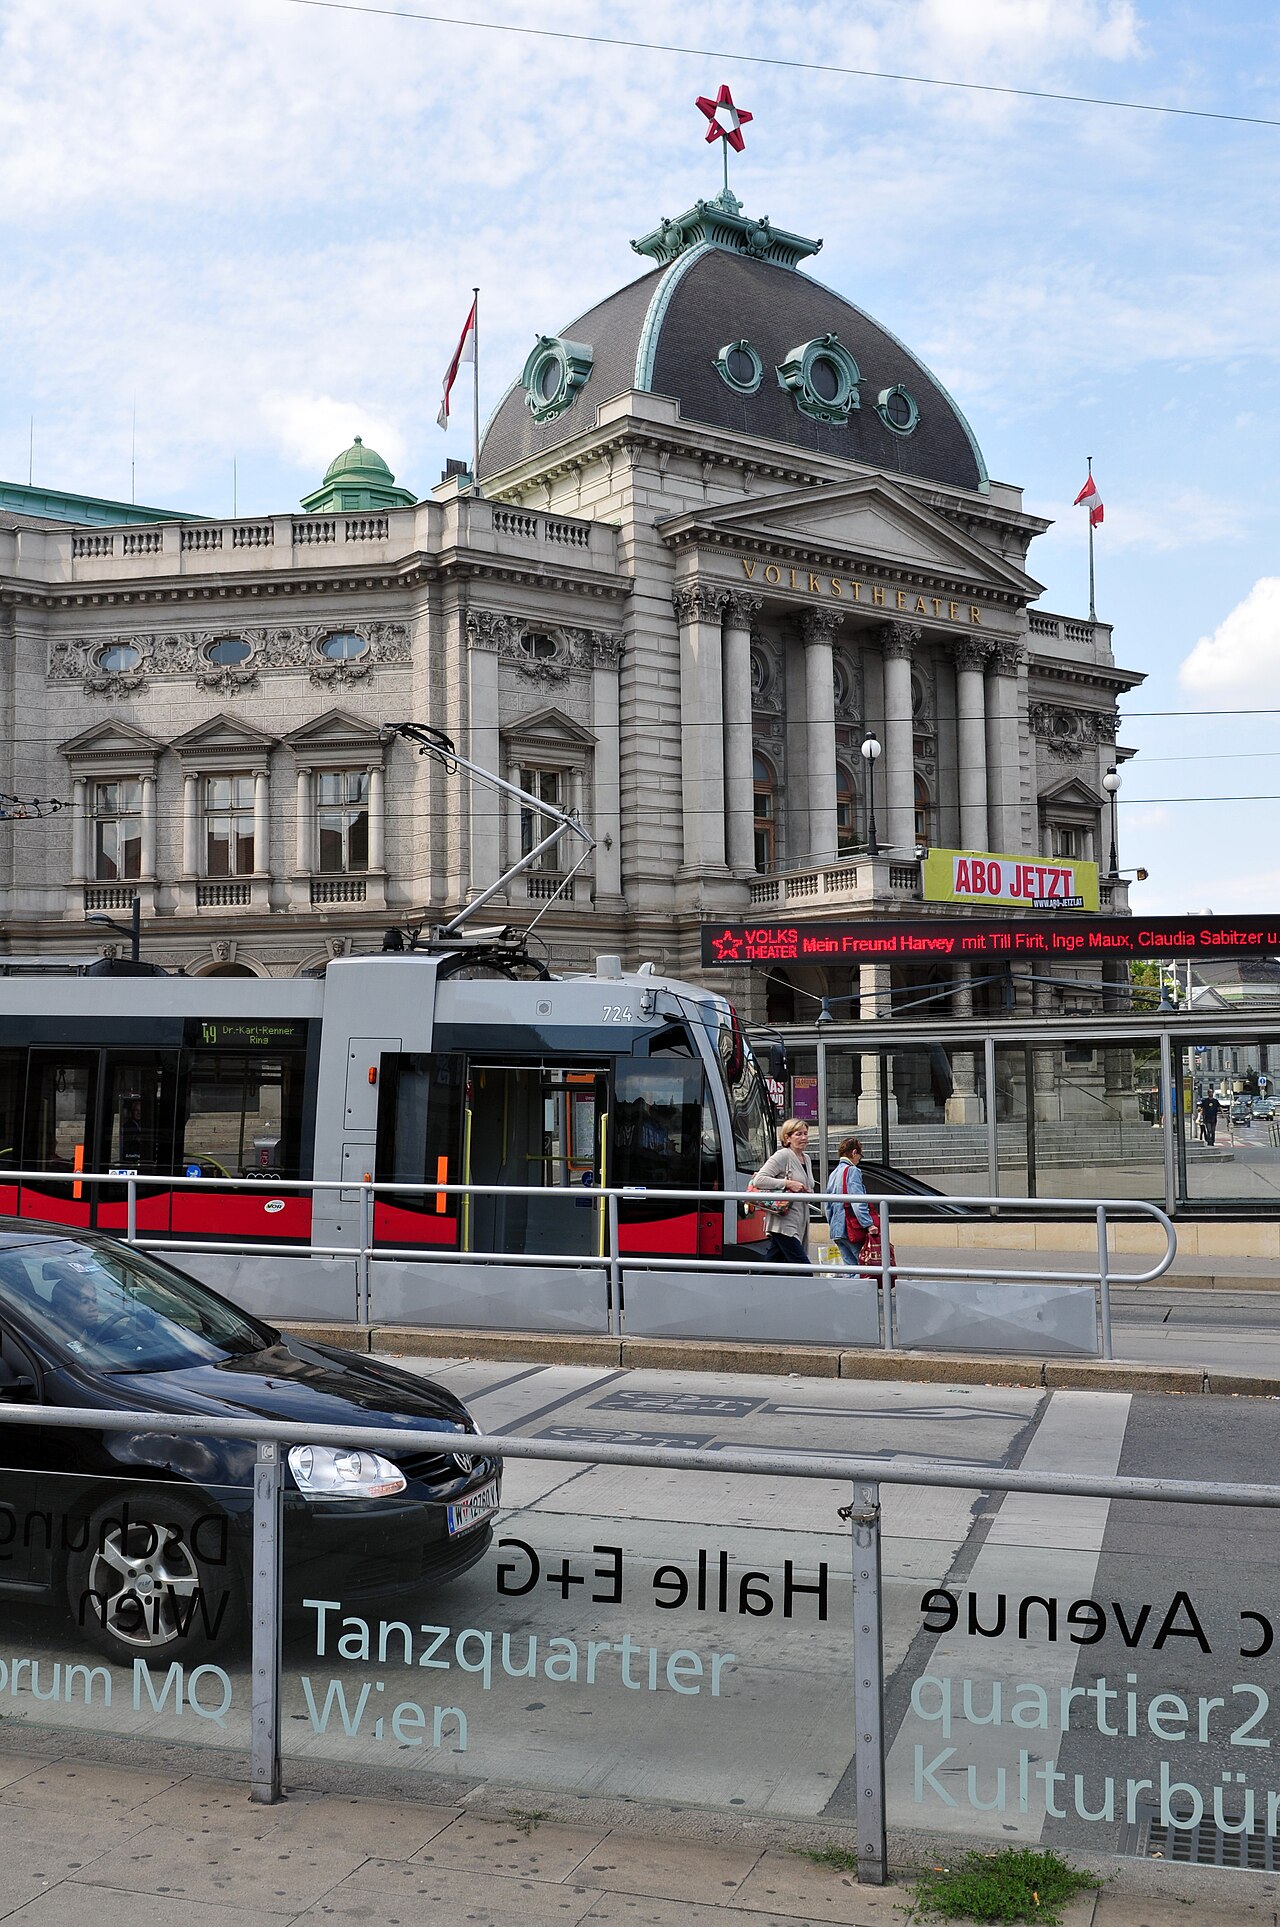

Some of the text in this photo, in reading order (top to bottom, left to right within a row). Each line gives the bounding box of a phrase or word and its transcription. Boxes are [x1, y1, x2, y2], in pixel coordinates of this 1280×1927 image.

[742, 559, 981, 624] VOLKSTHEATER
[955, 859, 1072, 898] ABO JETZT
[744, 929, 798, 944] VOLKS
[803, 935, 838, 953] Mein
[842, 935, 897, 951] Freund
[900, 935, 955, 953] Harvey
[961, 934, 986, 949] mit
[988, 933, 1011, 949] Till
[1015, 933, 1049, 951] Firit,
[1052, 933, 1084, 951] Inge
[1089, 932, 1134, 950] Maux,
[1138, 930, 1195, 947] Claudia
[1200, 929, 1264, 945] Sabitzer
[744, 945, 797, 959] THEATER
[602, 1006, 632, 1022] 724
[202, 1025, 217, 1044] 49
[222, 1025, 295, 1035] Dr.-Karl-Renner
[249, 1035, 269, 1045] Ring
[302, 1598, 735, 1697] Tanzquartier
[132, 1657, 233, 1729] MQ
[300, 1675, 467, 1751] Wien
[910, 1673, 1271, 1748] quartier2
